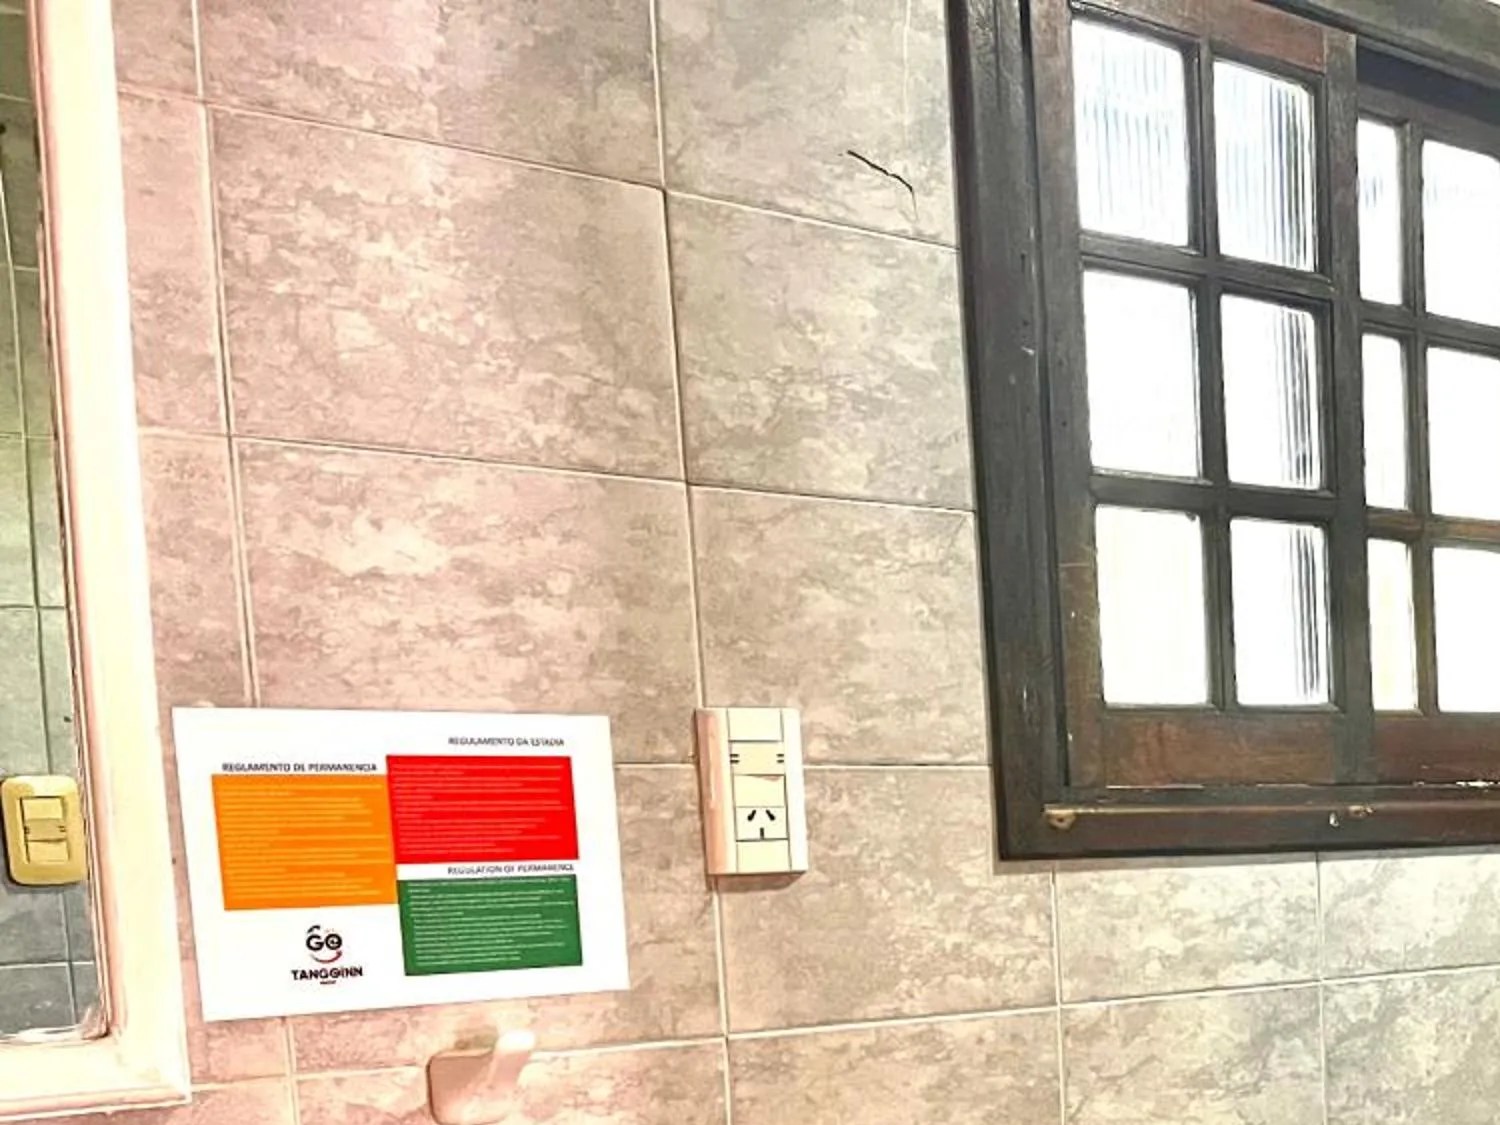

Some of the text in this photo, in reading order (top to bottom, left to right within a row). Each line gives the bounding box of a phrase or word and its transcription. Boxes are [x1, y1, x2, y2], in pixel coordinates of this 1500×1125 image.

[221, 763, 378, 772] REGLAMENTO DE PERMANENCIA
[503, 865, 515, 874] OF
